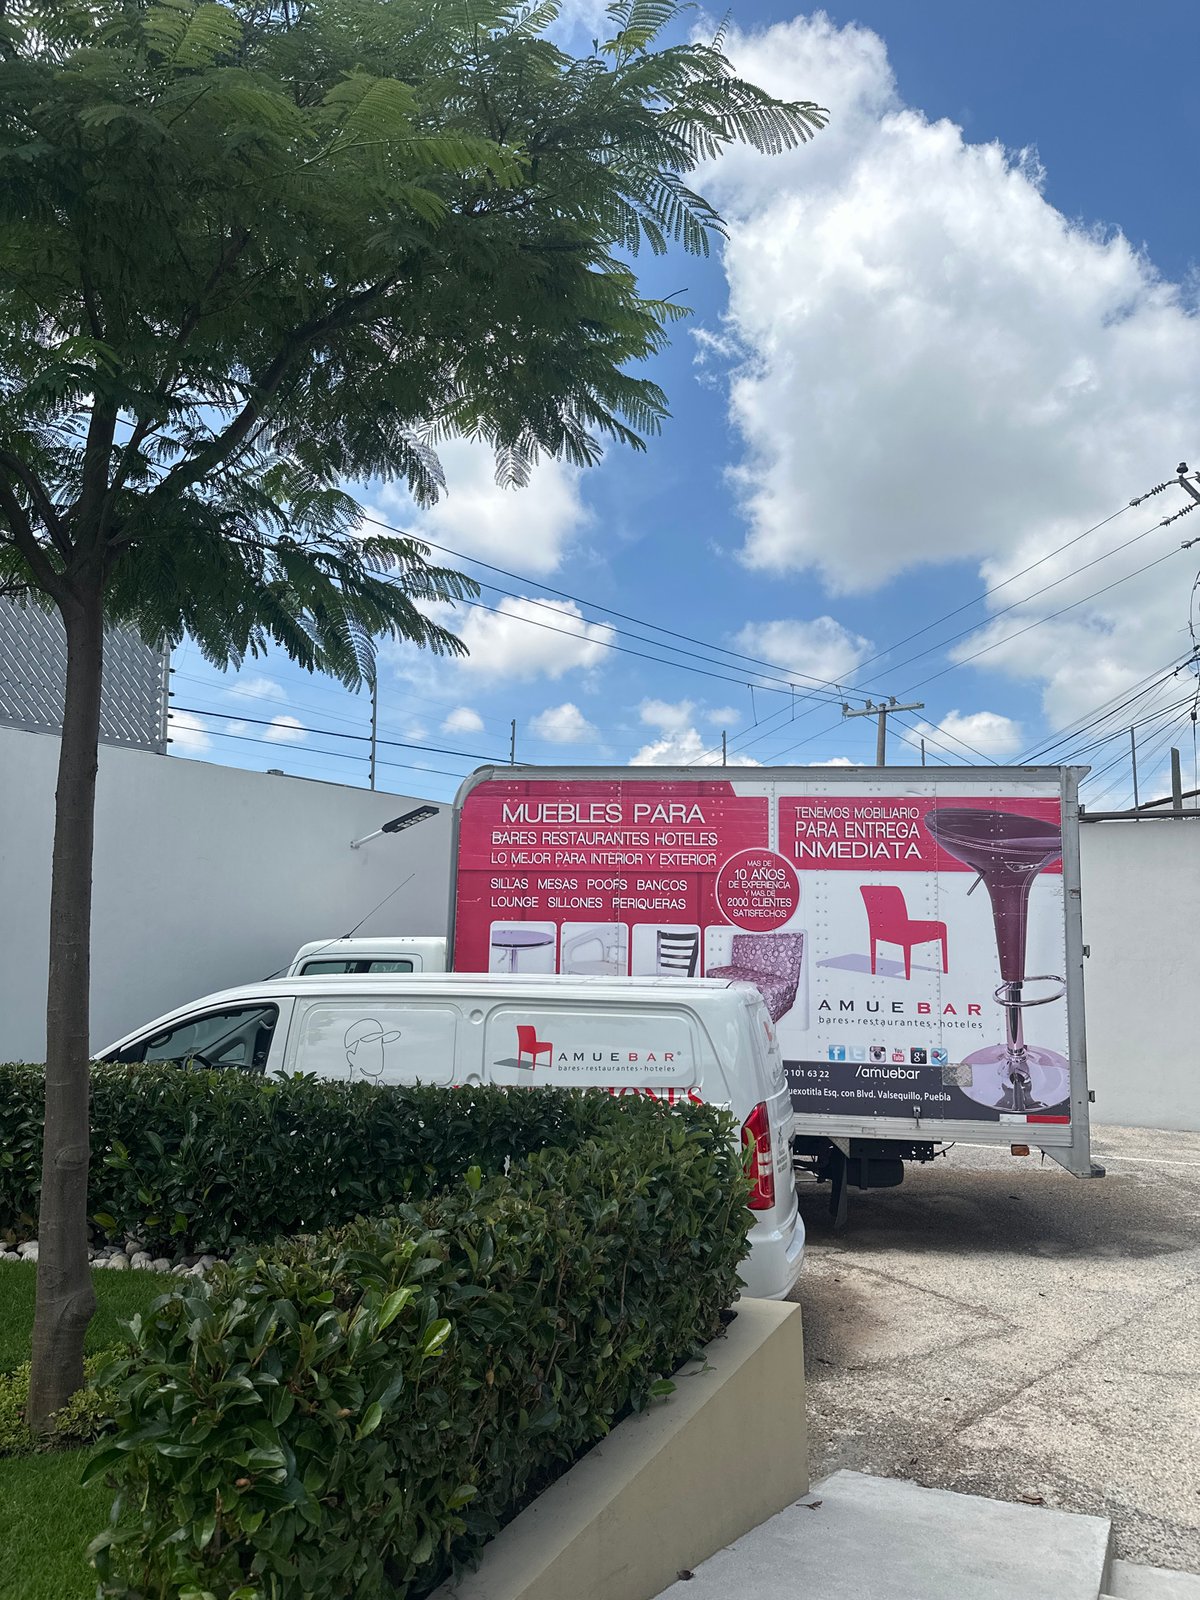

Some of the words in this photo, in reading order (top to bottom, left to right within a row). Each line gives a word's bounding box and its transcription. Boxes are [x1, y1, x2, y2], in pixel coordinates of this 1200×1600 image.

[502, 803, 623, 824] MUEBLES
[633, 804, 706, 824] PARA
[795, 806, 850, 819] TENEMOS
[854, 807, 920, 820] MOBILIARIO
[795, 821, 839, 838] PARA
[845, 822, 921, 839] ENTREGA
[491, 832, 537, 845] BARES
[542, 832, 649, 846] RESTAURANTES
[655, 833, 718, 846] HOTELES
[794, 841, 922, 860] INMEDIATA
[491, 852, 507, 864] LO
[511, 852, 551, 865] MEJOR
[555, 853, 587, 865] PARA
[591, 854, 643, 866] INTERIOR
[646, 855, 654, 866] Y
[659, 855, 717, 867] EXTERIOR
[734, 869, 747, 880] 10
[751, 867, 786, 880] AÑOS
[490, 878, 528, 890] SILLAS
[537, 879, 578, 890] MESAS
[586, 879, 628, 891] POOFS
[636, 880, 688, 892] BANCOS
[728, 880, 740, 889] DE
[741, 880, 791, 889] EXPERIENCIA
[491, 897, 539, 909] LOUNGE
[547, 897, 603, 910] SILLONES
[612, 898, 687, 911] PERIQUERAS
[727, 898, 749, 907] 2000
[751, 898, 792, 907] CLIENTES
[733, 909, 787, 918] SATISFECHOS
[818, 999, 982, 1016] AMUEBAR
[558, 1052, 674, 1062] AMUEBAR
[791, 1069, 805, 1077] 101
[807, 1069, 818, 1078] 63
[819, 1070, 830, 1078] 22
[855, 1065, 920, 1080] /amuebar
[823, 1088, 840, 1097] Esq.
[840, 1090, 855, 1098] con
[857, 1090, 876, 1099] Blvd.
[877, 1090, 923, 1101] Valsequillo,
[924, 1092, 951, 1102] Puebla
